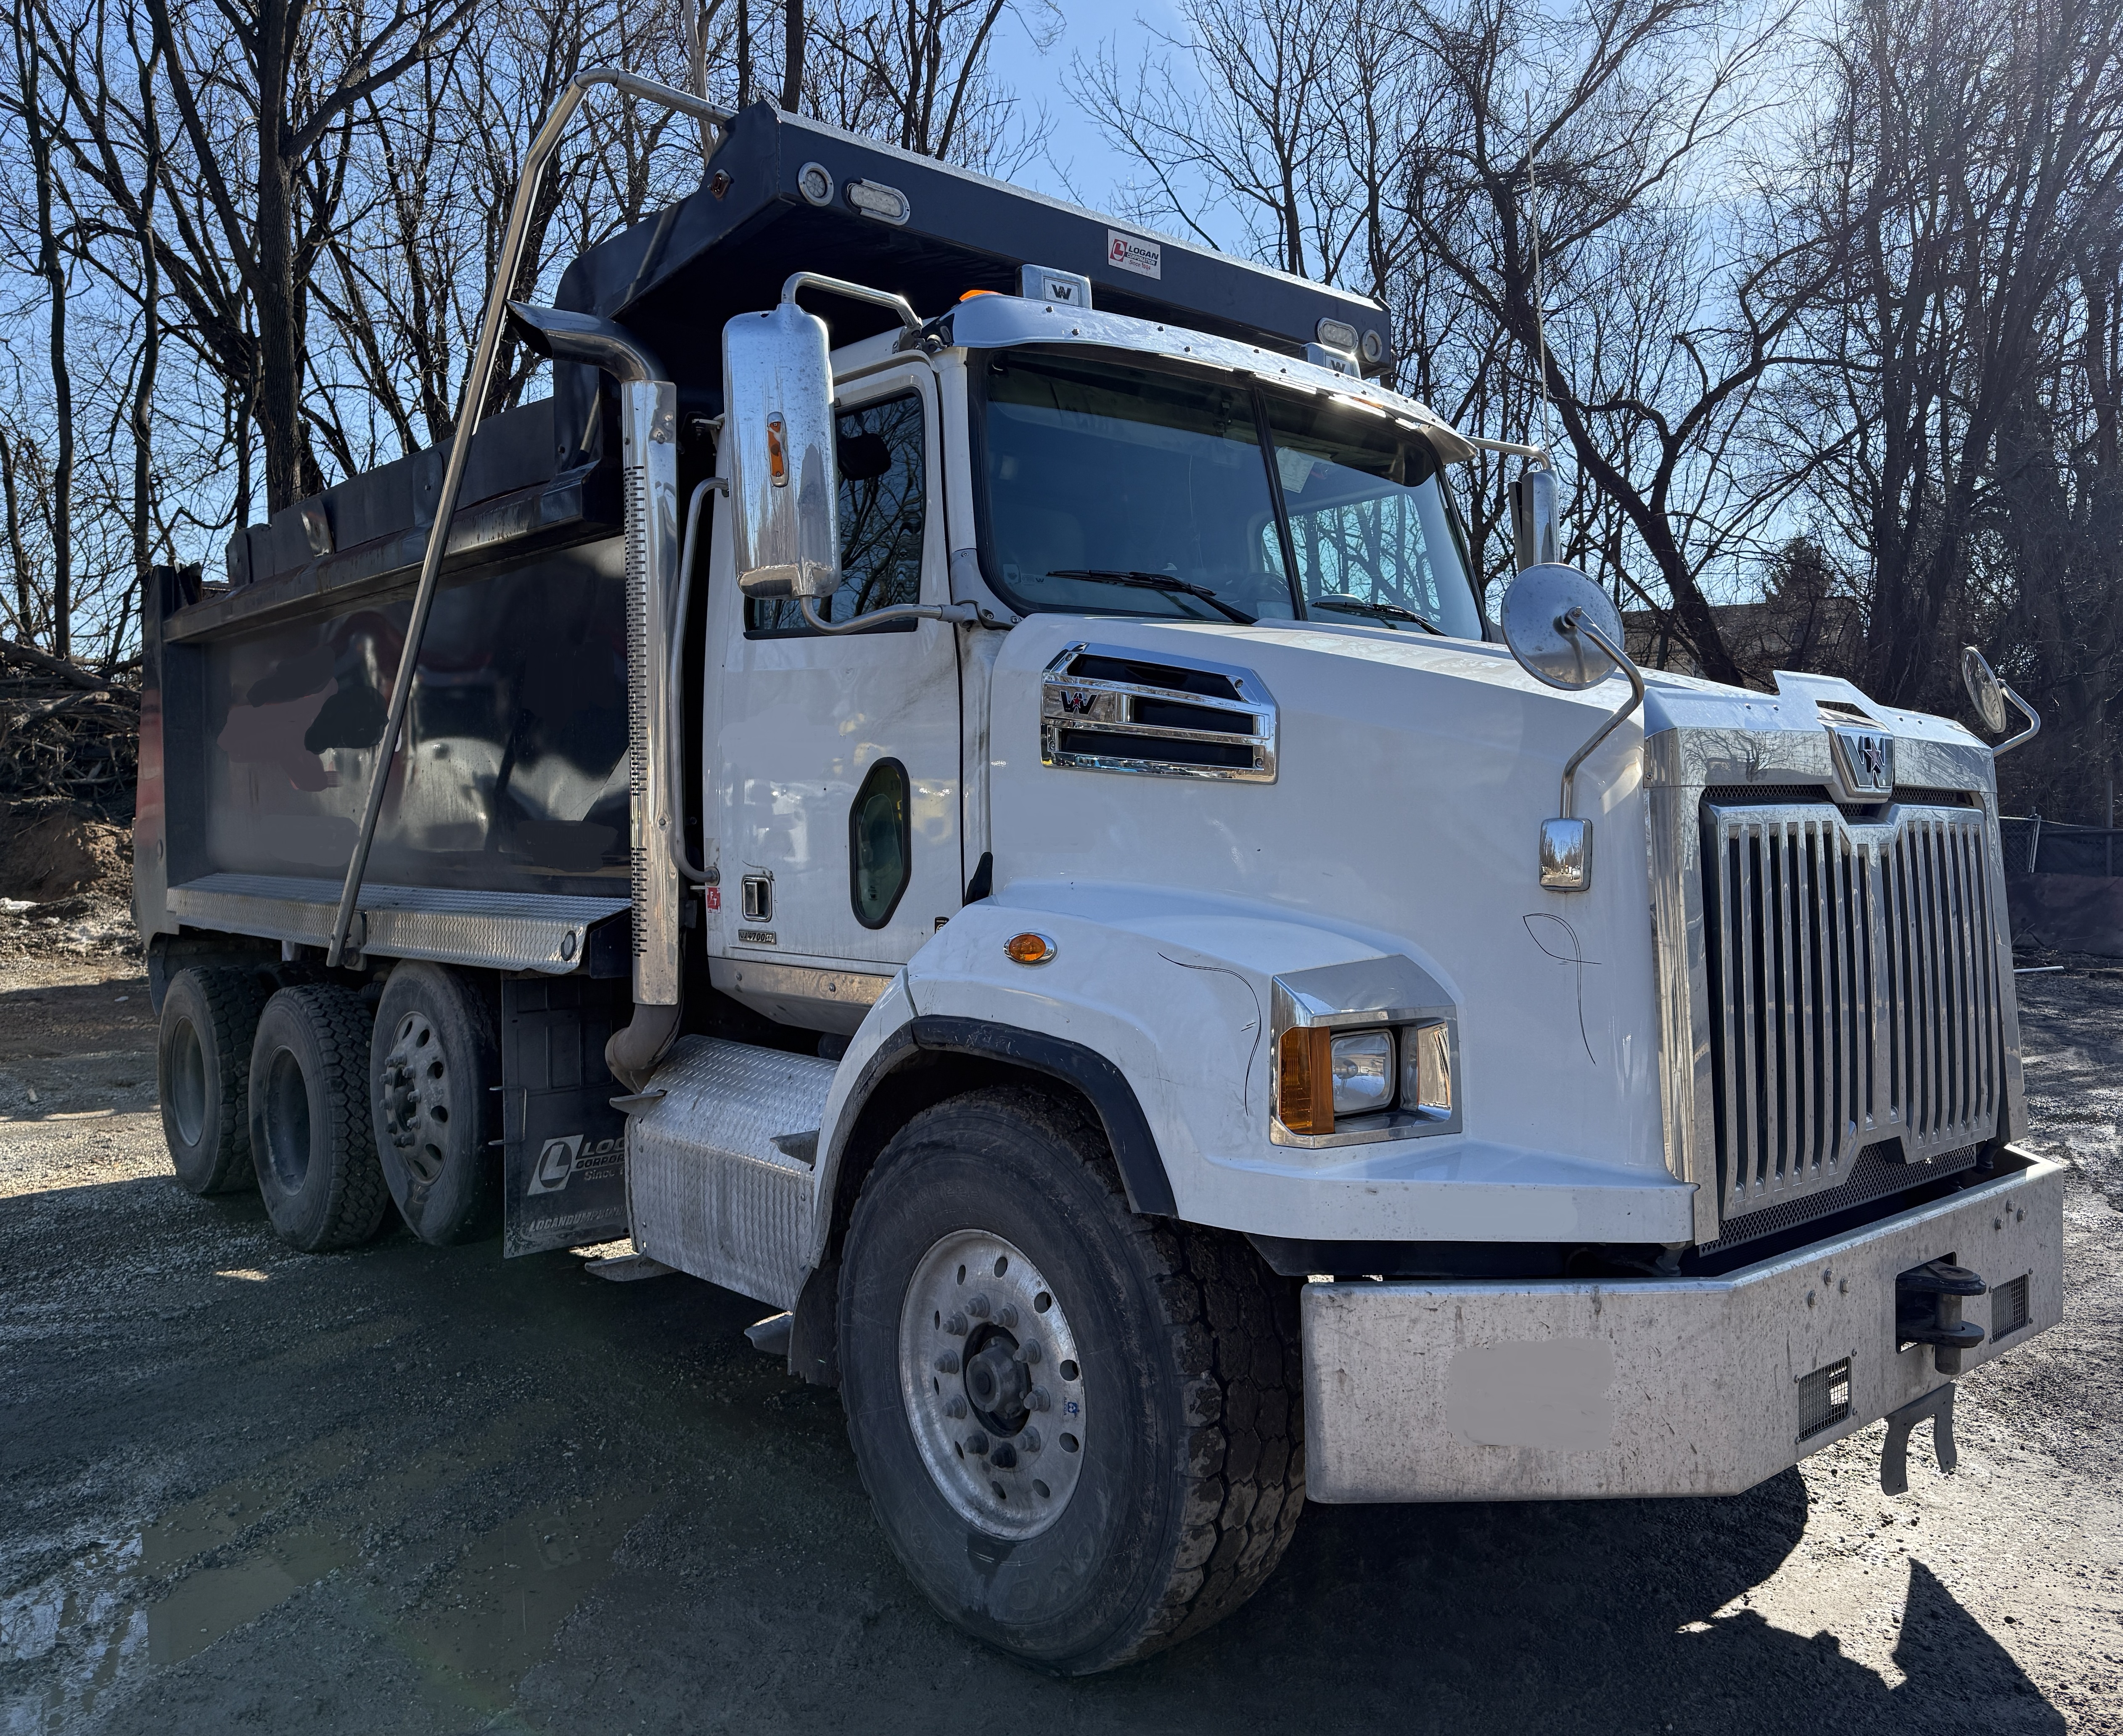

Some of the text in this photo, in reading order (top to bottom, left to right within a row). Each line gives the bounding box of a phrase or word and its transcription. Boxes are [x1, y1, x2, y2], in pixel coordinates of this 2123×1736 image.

[1127, 253, 1155, 265] CORPORATION
[1128, 246, 1159, 260] LOGAN
[576, 1154, 624, 1168] CORPOR
[584, 1169, 615, 1181] Since
